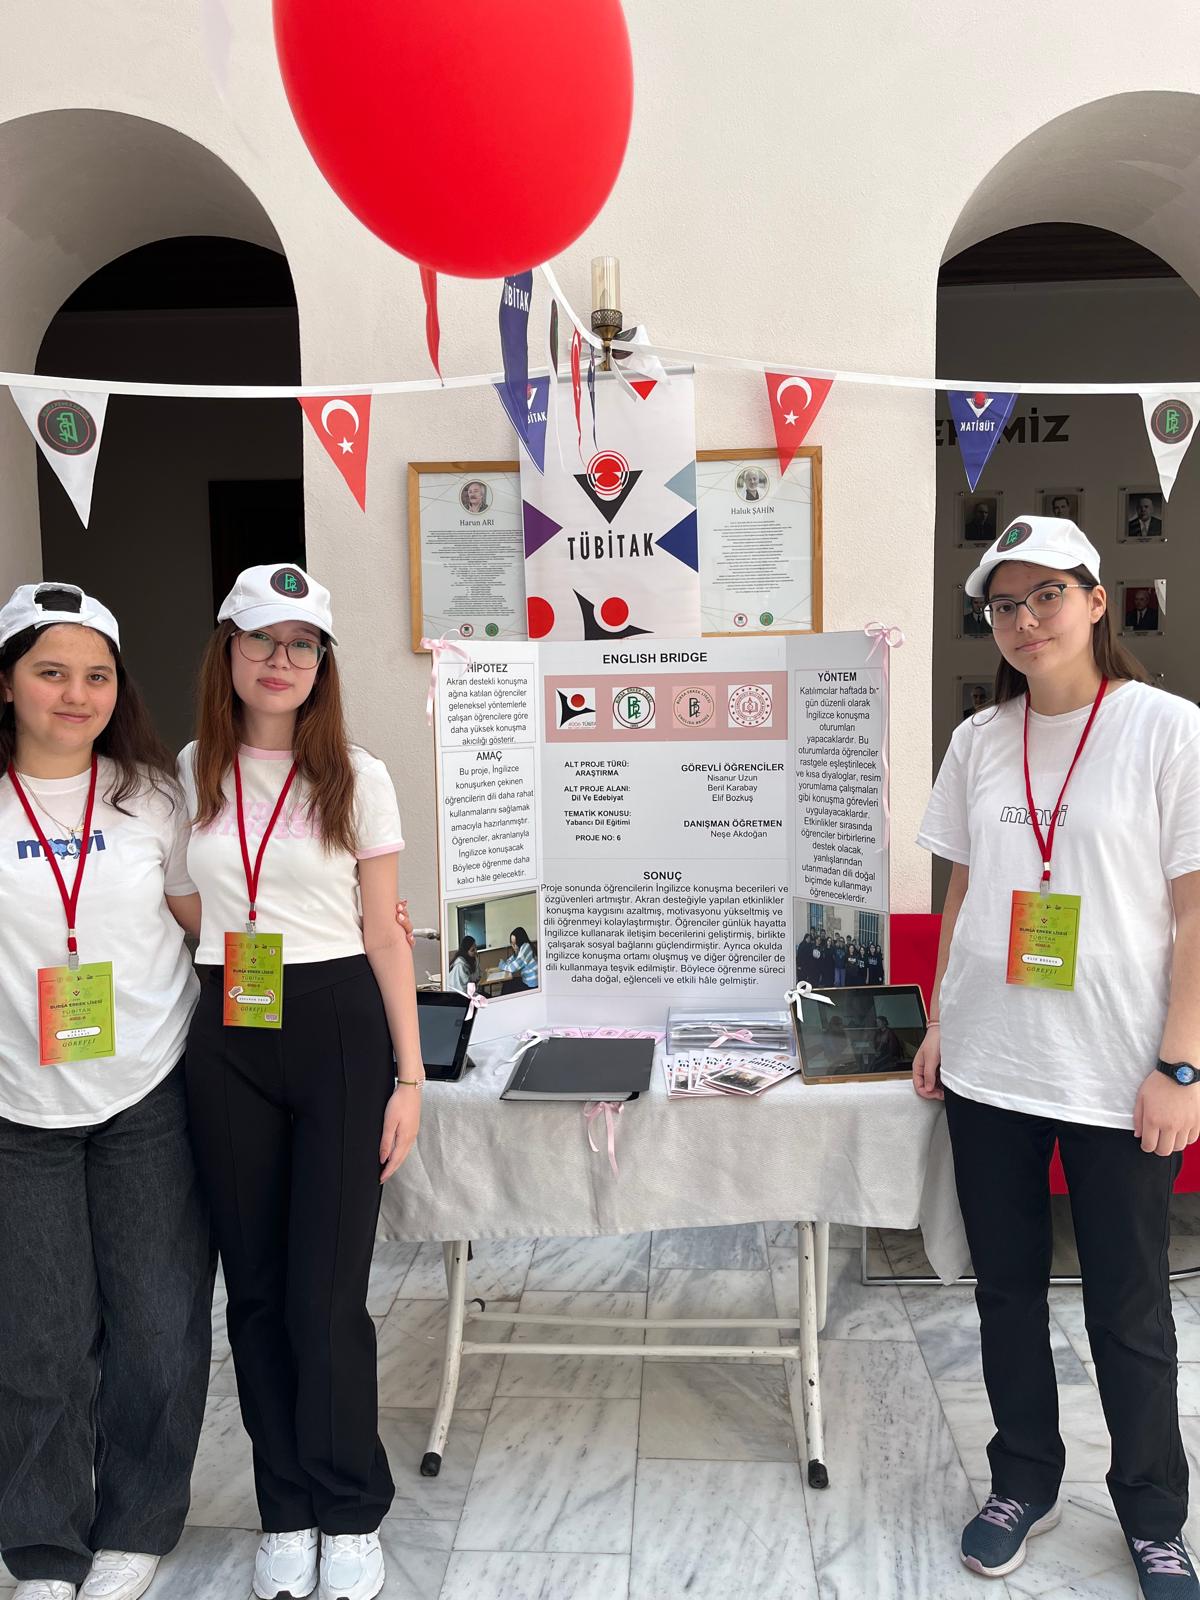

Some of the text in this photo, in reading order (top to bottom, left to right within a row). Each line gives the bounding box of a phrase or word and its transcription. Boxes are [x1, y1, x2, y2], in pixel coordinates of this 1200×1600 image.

[731, 505, 775, 515] Haluk ŞAHİN
[459, 519, 481, 527] Harun
[567, 530, 654, 560] TÜBİTAK
[603, 652, 708, 664] ENGLISH BRIDGE
[467, 662, 508, 673] HİPOTEZ
[818, 670, 857, 682] YÖNTEM
[446, 678, 528, 686] Akran destekli konuşma
[448, 689, 527, 699] ağına katılan öğrenciler
[448, 701, 527, 711] geleneksel yöntemlerle
[805, 698, 871, 709] gün düzenli olarak
[447, 712, 529, 723] çalışan öğrencilere göre
[806, 710, 870, 721] İngilizce konuşma
[450, 726, 469, 734] daha
[470, 725, 495, 735] yüksek
[462, 737, 488, 746] akıcılığı
[858, 735, 869, 745] Bu
[476, 751, 502, 762] AMAÇ
[607, 760, 629, 768] TÜRÜ:
[681, 763, 784, 772] GÖREVLİ ÖĞRENCİLER
[707, 774, 758, 782] Nisanur Uzun
[564, 785, 578, 793] ALT
[708, 784, 758, 792] Beril Karabay
[571, 794, 624, 802] Dil Ve Edebiyat
[712, 794, 754, 803] Elif Bozkuş
[1000, 804, 1068, 826] mavi
[606, 819, 631, 827] Eğitimi
[684, 819, 782, 828] DANIŞMAN ÖĞRETMEN
[710, 830, 768, 839] Neşe Akdoğan
[452, 856, 530, 872] Böylece öğrenme daha
[457, 877, 475, 885] kalıcı
[643, 871, 682, 881] SONUÇ
[541, 884, 563, 894] Proje
[604, 884, 654, 894] öğrencilerin
[656, 883, 691, 894] İngilizce
[693, 885, 733, 894] konuşma
[736, 884, 776, 893] becerileri
[544, 895, 784, 906] özgüvenleri artmıştır. Akran desteğiyle yapılan etkinlikler
[546, 907, 585, 915] konuşma
[587, 907, 624, 916] kaygısını
[626, 907, 664, 916] azaltmış,
[666, 908, 722, 917] motivasyonu
[724, 907, 770, 917] yükseltmiş
[543, 917, 786, 929] dili öğrenmeyi kolaylaştırmıştır. Öğrenciler günlük hayatta
[544, 928, 786, 940] İngilizce kullanarak iletişim becerilerini geliştirmiş, birlikte
[547, 940, 783, 951] çalışarak sosyal bağlarını güçlendirmiştir. Ayrıca okulda
[546, 951, 580, 962] İngilizce
[582, 952, 621, 962] konuşma
[652, 953, 689, 962] oluşmuş
[690, 954, 702, 962] ve
[704, 953, 726, 964] diğer
[728, 953, 772, 963] öğrenciler
[774, 954, 786, 963] de
[546, 963, 786, 975] dili kullanmaya teşvik edilmiştir. Böylece öğrenme süreci
[571, 975, 593, 983] daha
[594, 975, 621, 985] doğal,
[623, 975, 662, 985] eğlenceli
[676, 976, 696, 984] etkili
[698, 976, 718, 984] hâle
[719, 977, 759, 986] gelmiştir.
